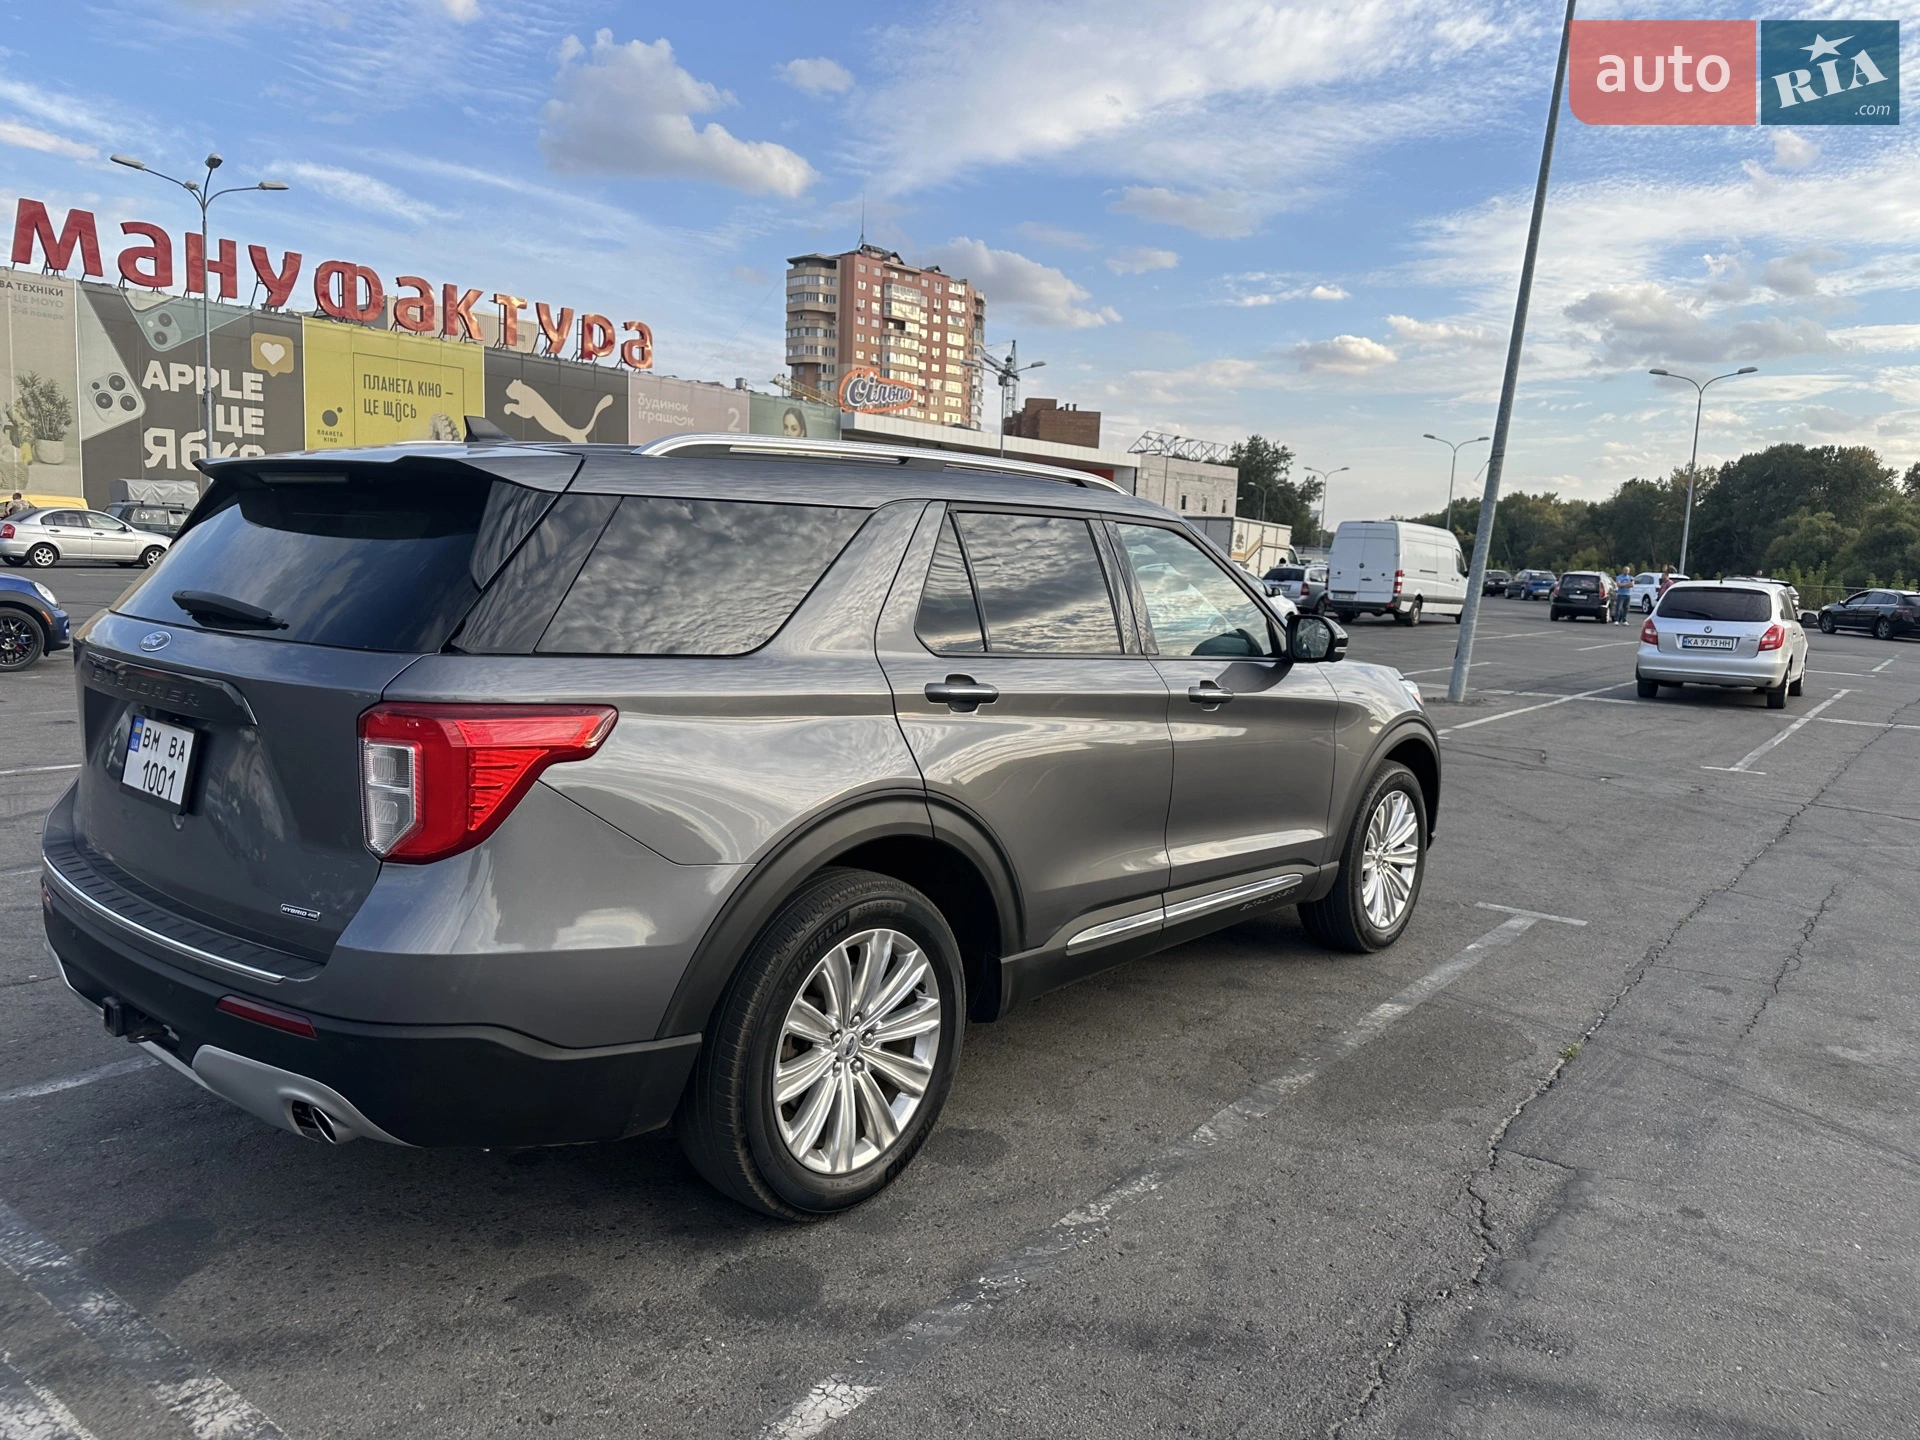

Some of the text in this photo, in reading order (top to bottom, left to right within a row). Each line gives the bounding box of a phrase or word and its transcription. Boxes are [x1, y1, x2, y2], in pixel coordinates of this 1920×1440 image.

[11, 197, 653, 370] Мануфактура
[16, 282, 64, 297] ТЕХНІКИ
[141, 360, 264, 402] APPLE
[363, 373, 414, 395] ПЛАНЕТА
[418, 381, 442, 398] КІНО
[363, 398, 379, 416] ЦЕ
[637, 392, 689, 412] будинок
[215, 404, 265, 438] ЦЕ
[727, 407, 741, 432] 2
[317, 429, 344, 438] ПЛАНЕТА
[1700, 639, 1718, 647] 9713
[142, 726, 185, 763] BM BA
[143, 759, 176, 800] 1001
[787, 915, 847, 985] MICHELIN
